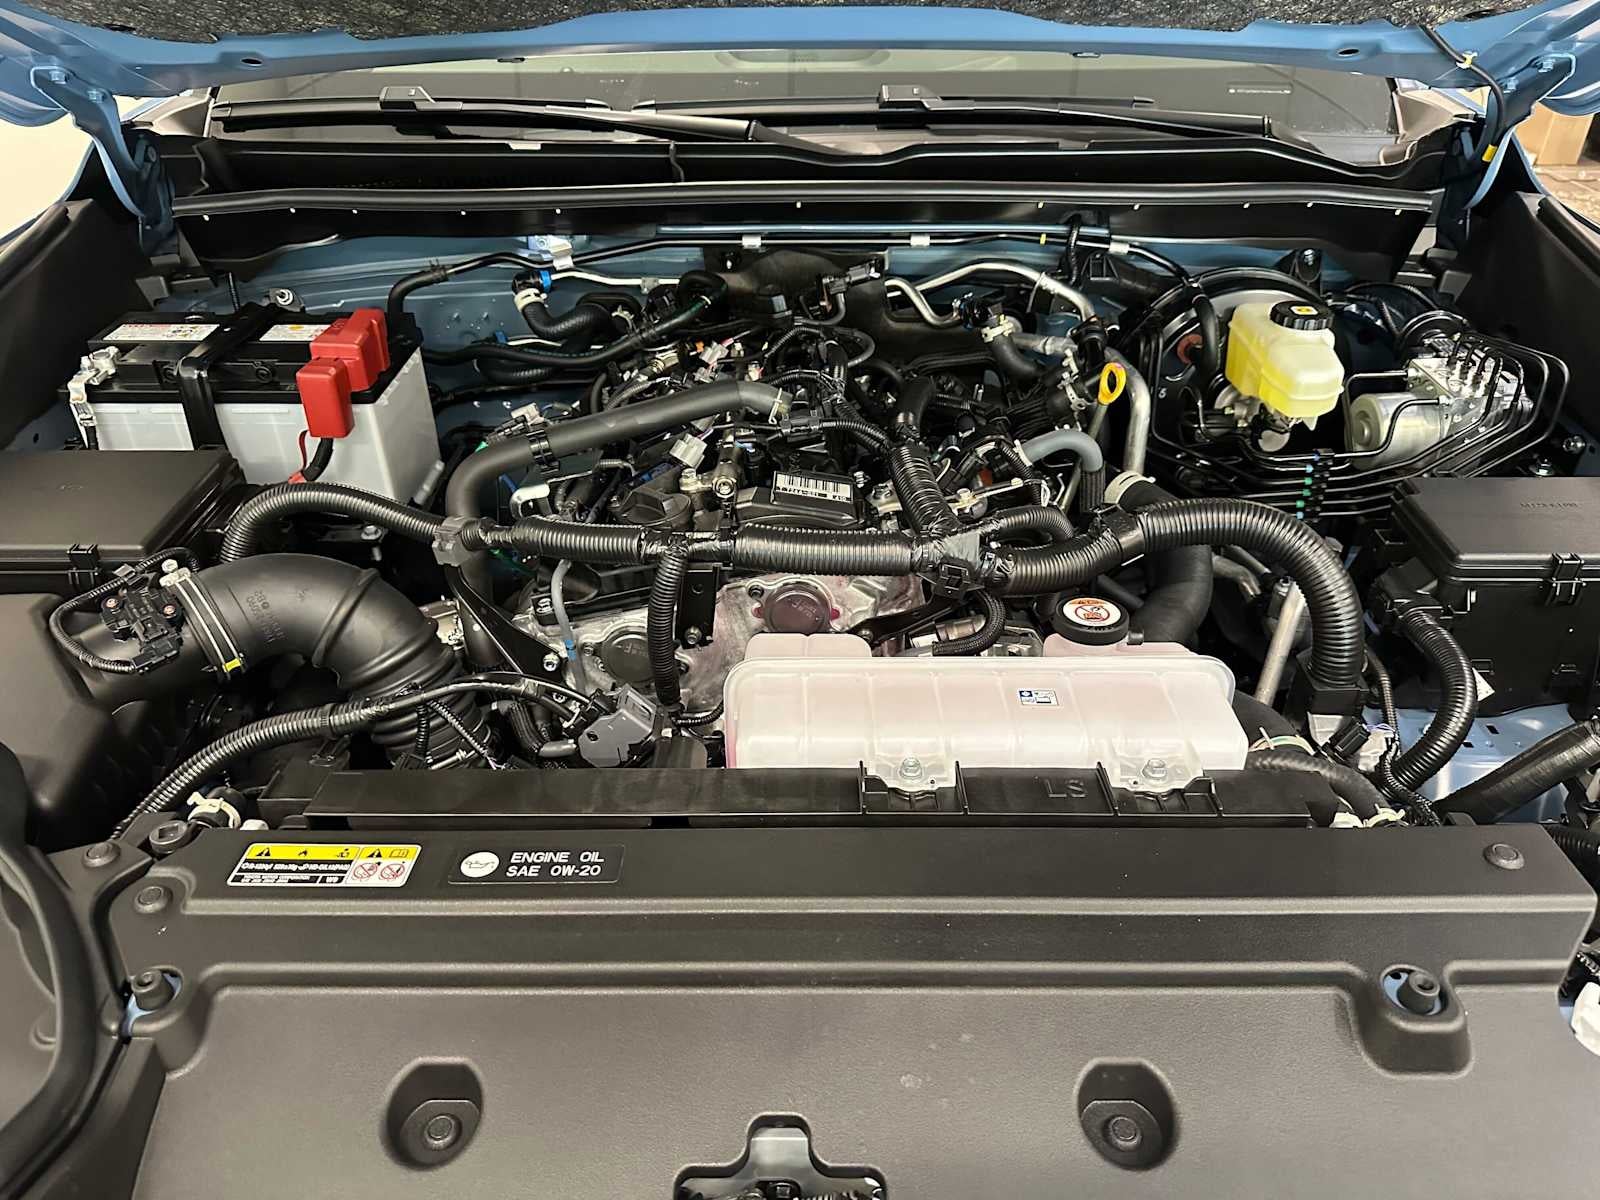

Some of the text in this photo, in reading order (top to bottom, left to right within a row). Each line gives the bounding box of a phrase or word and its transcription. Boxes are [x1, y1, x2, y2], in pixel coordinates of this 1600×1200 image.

[510, 851, 605, 863] ENGINE OIL
[506, 864, 602, 877] SAE 0W-20
